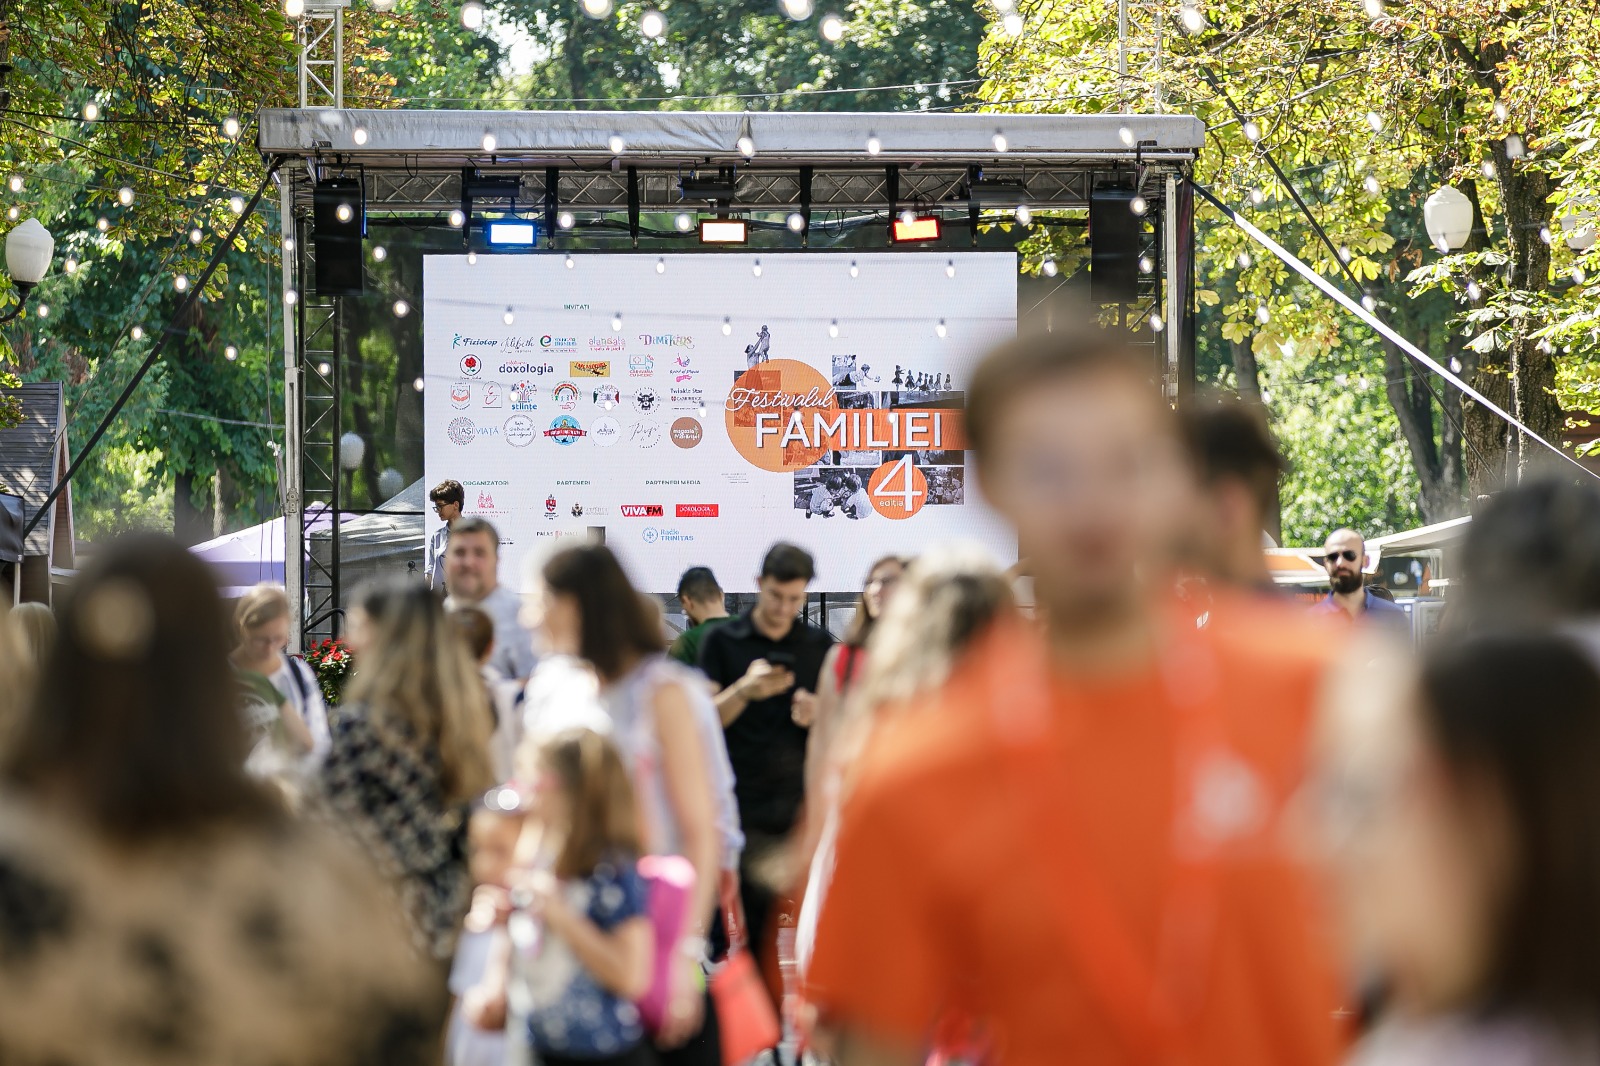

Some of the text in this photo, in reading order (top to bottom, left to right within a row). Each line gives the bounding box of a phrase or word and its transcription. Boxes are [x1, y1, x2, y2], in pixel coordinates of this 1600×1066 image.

[463, 337, 498, 347] Fiziotop
[499, 363, 554, 376] doxologia
[725, 386, 837, 411] Festivalul
[756, 411, 942, 449] FAMILIEI
[874, 452, 924, 513] 4
